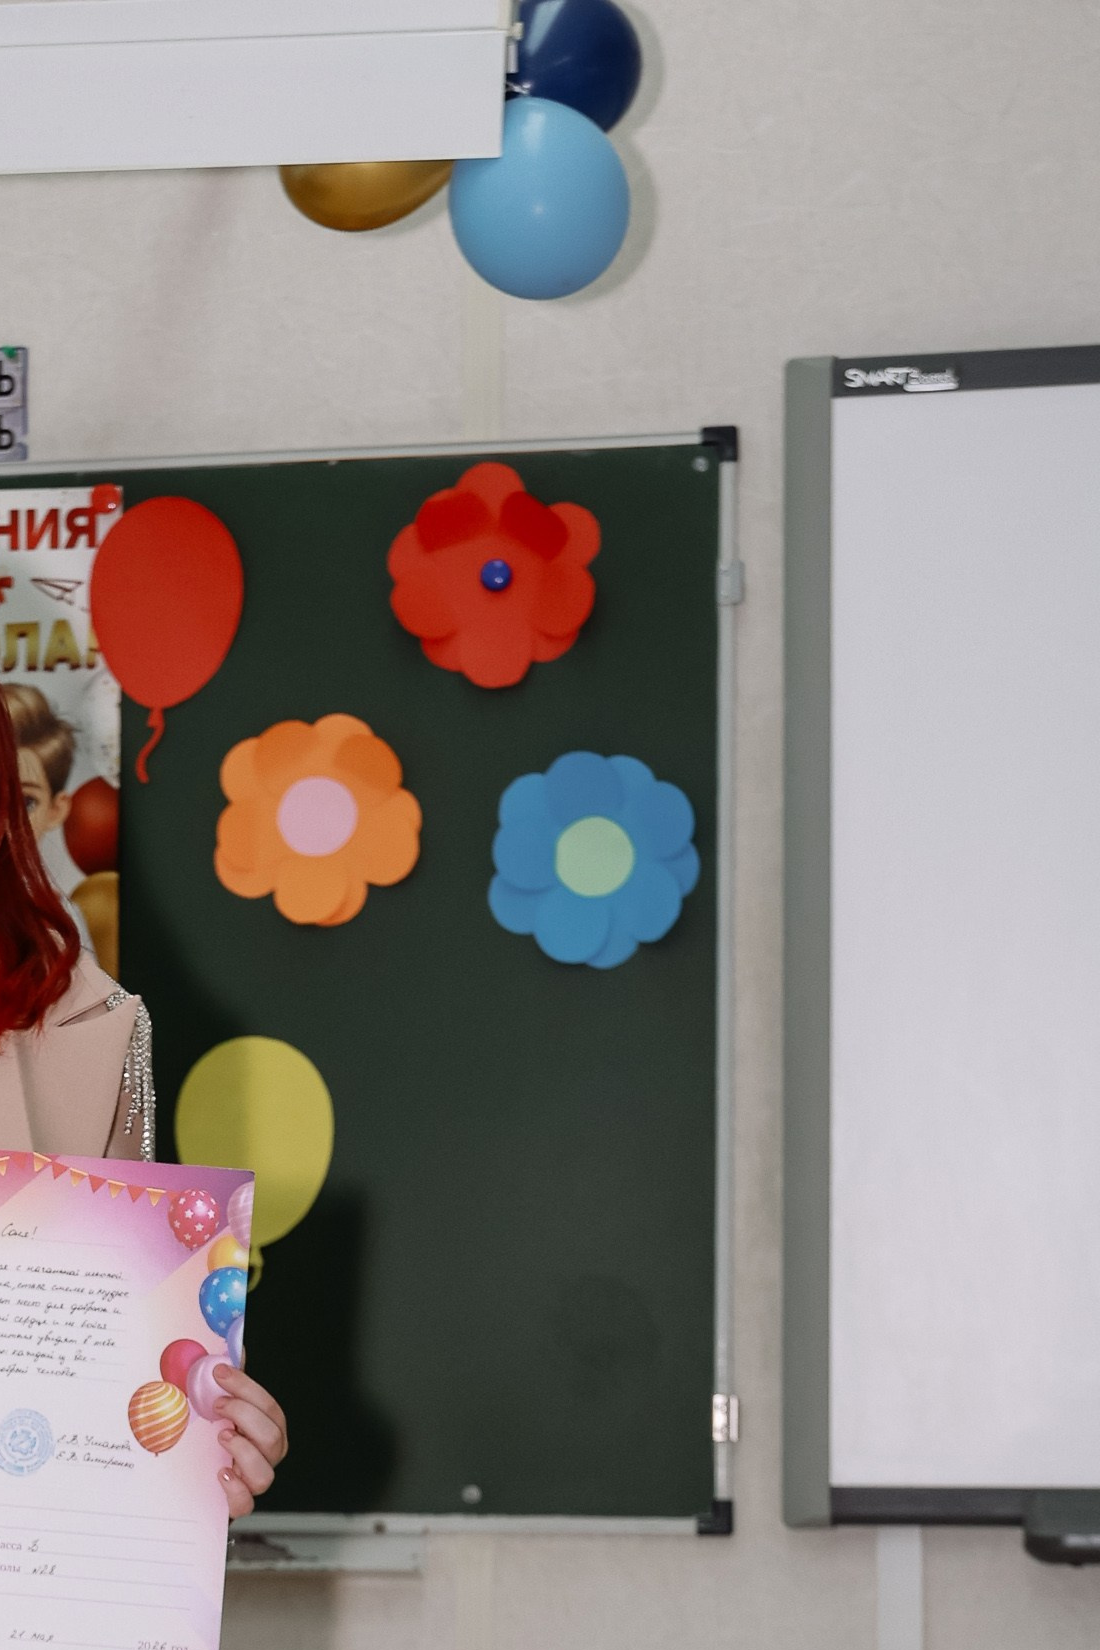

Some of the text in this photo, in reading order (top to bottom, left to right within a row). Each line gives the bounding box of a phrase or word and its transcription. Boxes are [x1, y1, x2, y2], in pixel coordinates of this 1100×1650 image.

[1, 1222, 38, 1240] Соня!
[27, 1266, 79, 1277] начальной
[31, 1633, 55, 1643] мая
